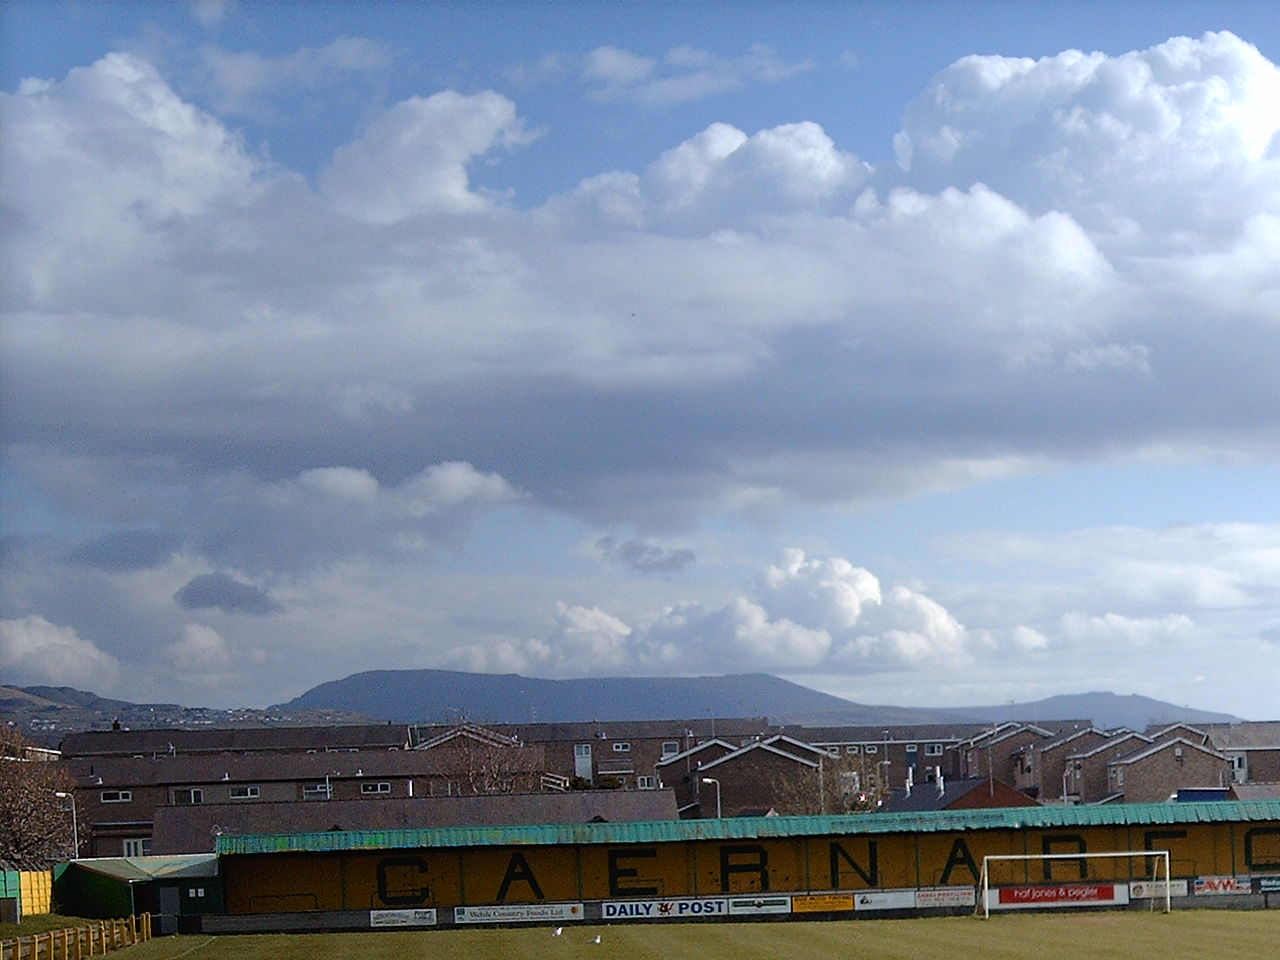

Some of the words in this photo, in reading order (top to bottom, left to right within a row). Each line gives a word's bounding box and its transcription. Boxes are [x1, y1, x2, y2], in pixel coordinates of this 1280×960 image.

[1031, 887, 1056, 898] jones
[1059, 887, 1066, 896] &
[493, 908, 524, 919] Country
[526, 908, 548, 916] Foods
[606, 903, 652, 917] DAILY
[678, 901, 724, 914] POST
